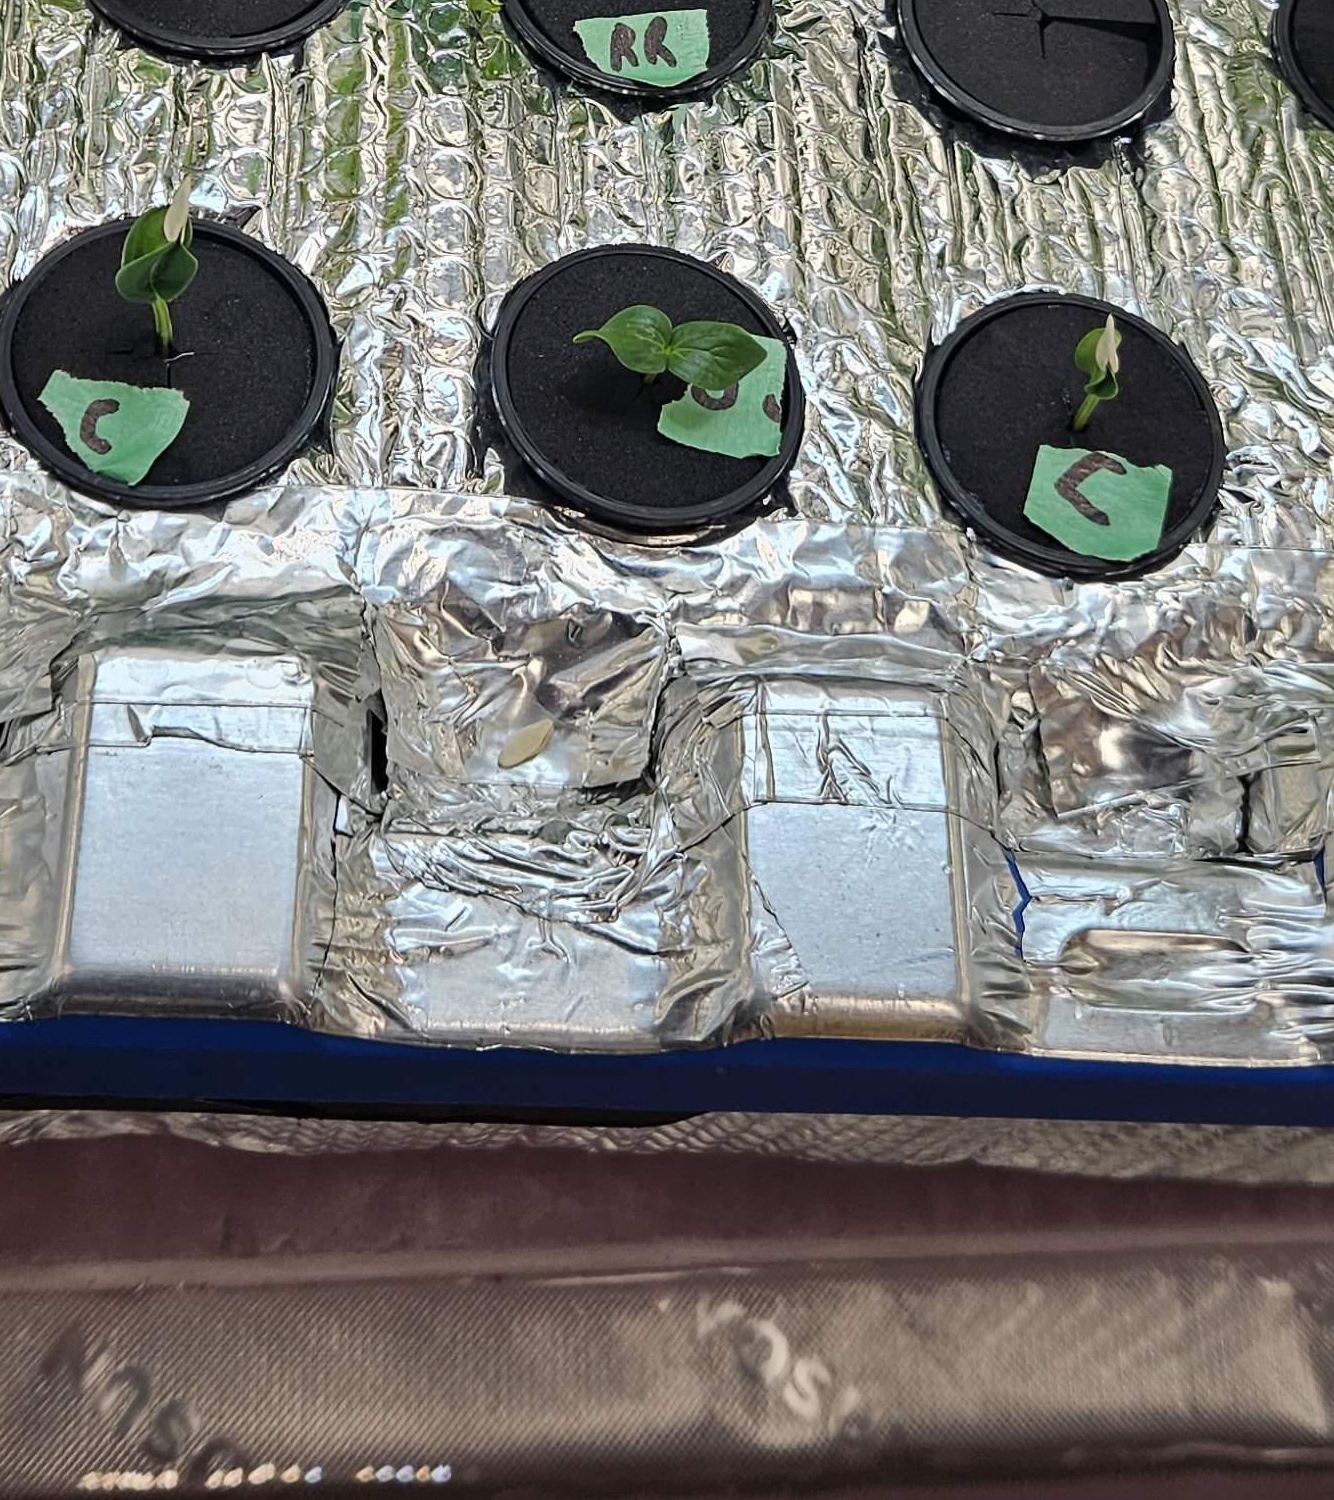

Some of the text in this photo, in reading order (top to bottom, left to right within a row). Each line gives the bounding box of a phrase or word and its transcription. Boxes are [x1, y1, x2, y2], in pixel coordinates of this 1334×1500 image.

[609, 15, 678, 73] RR
[79, 398, 121, 455] C
[1053, 451, 1128, 527] C
